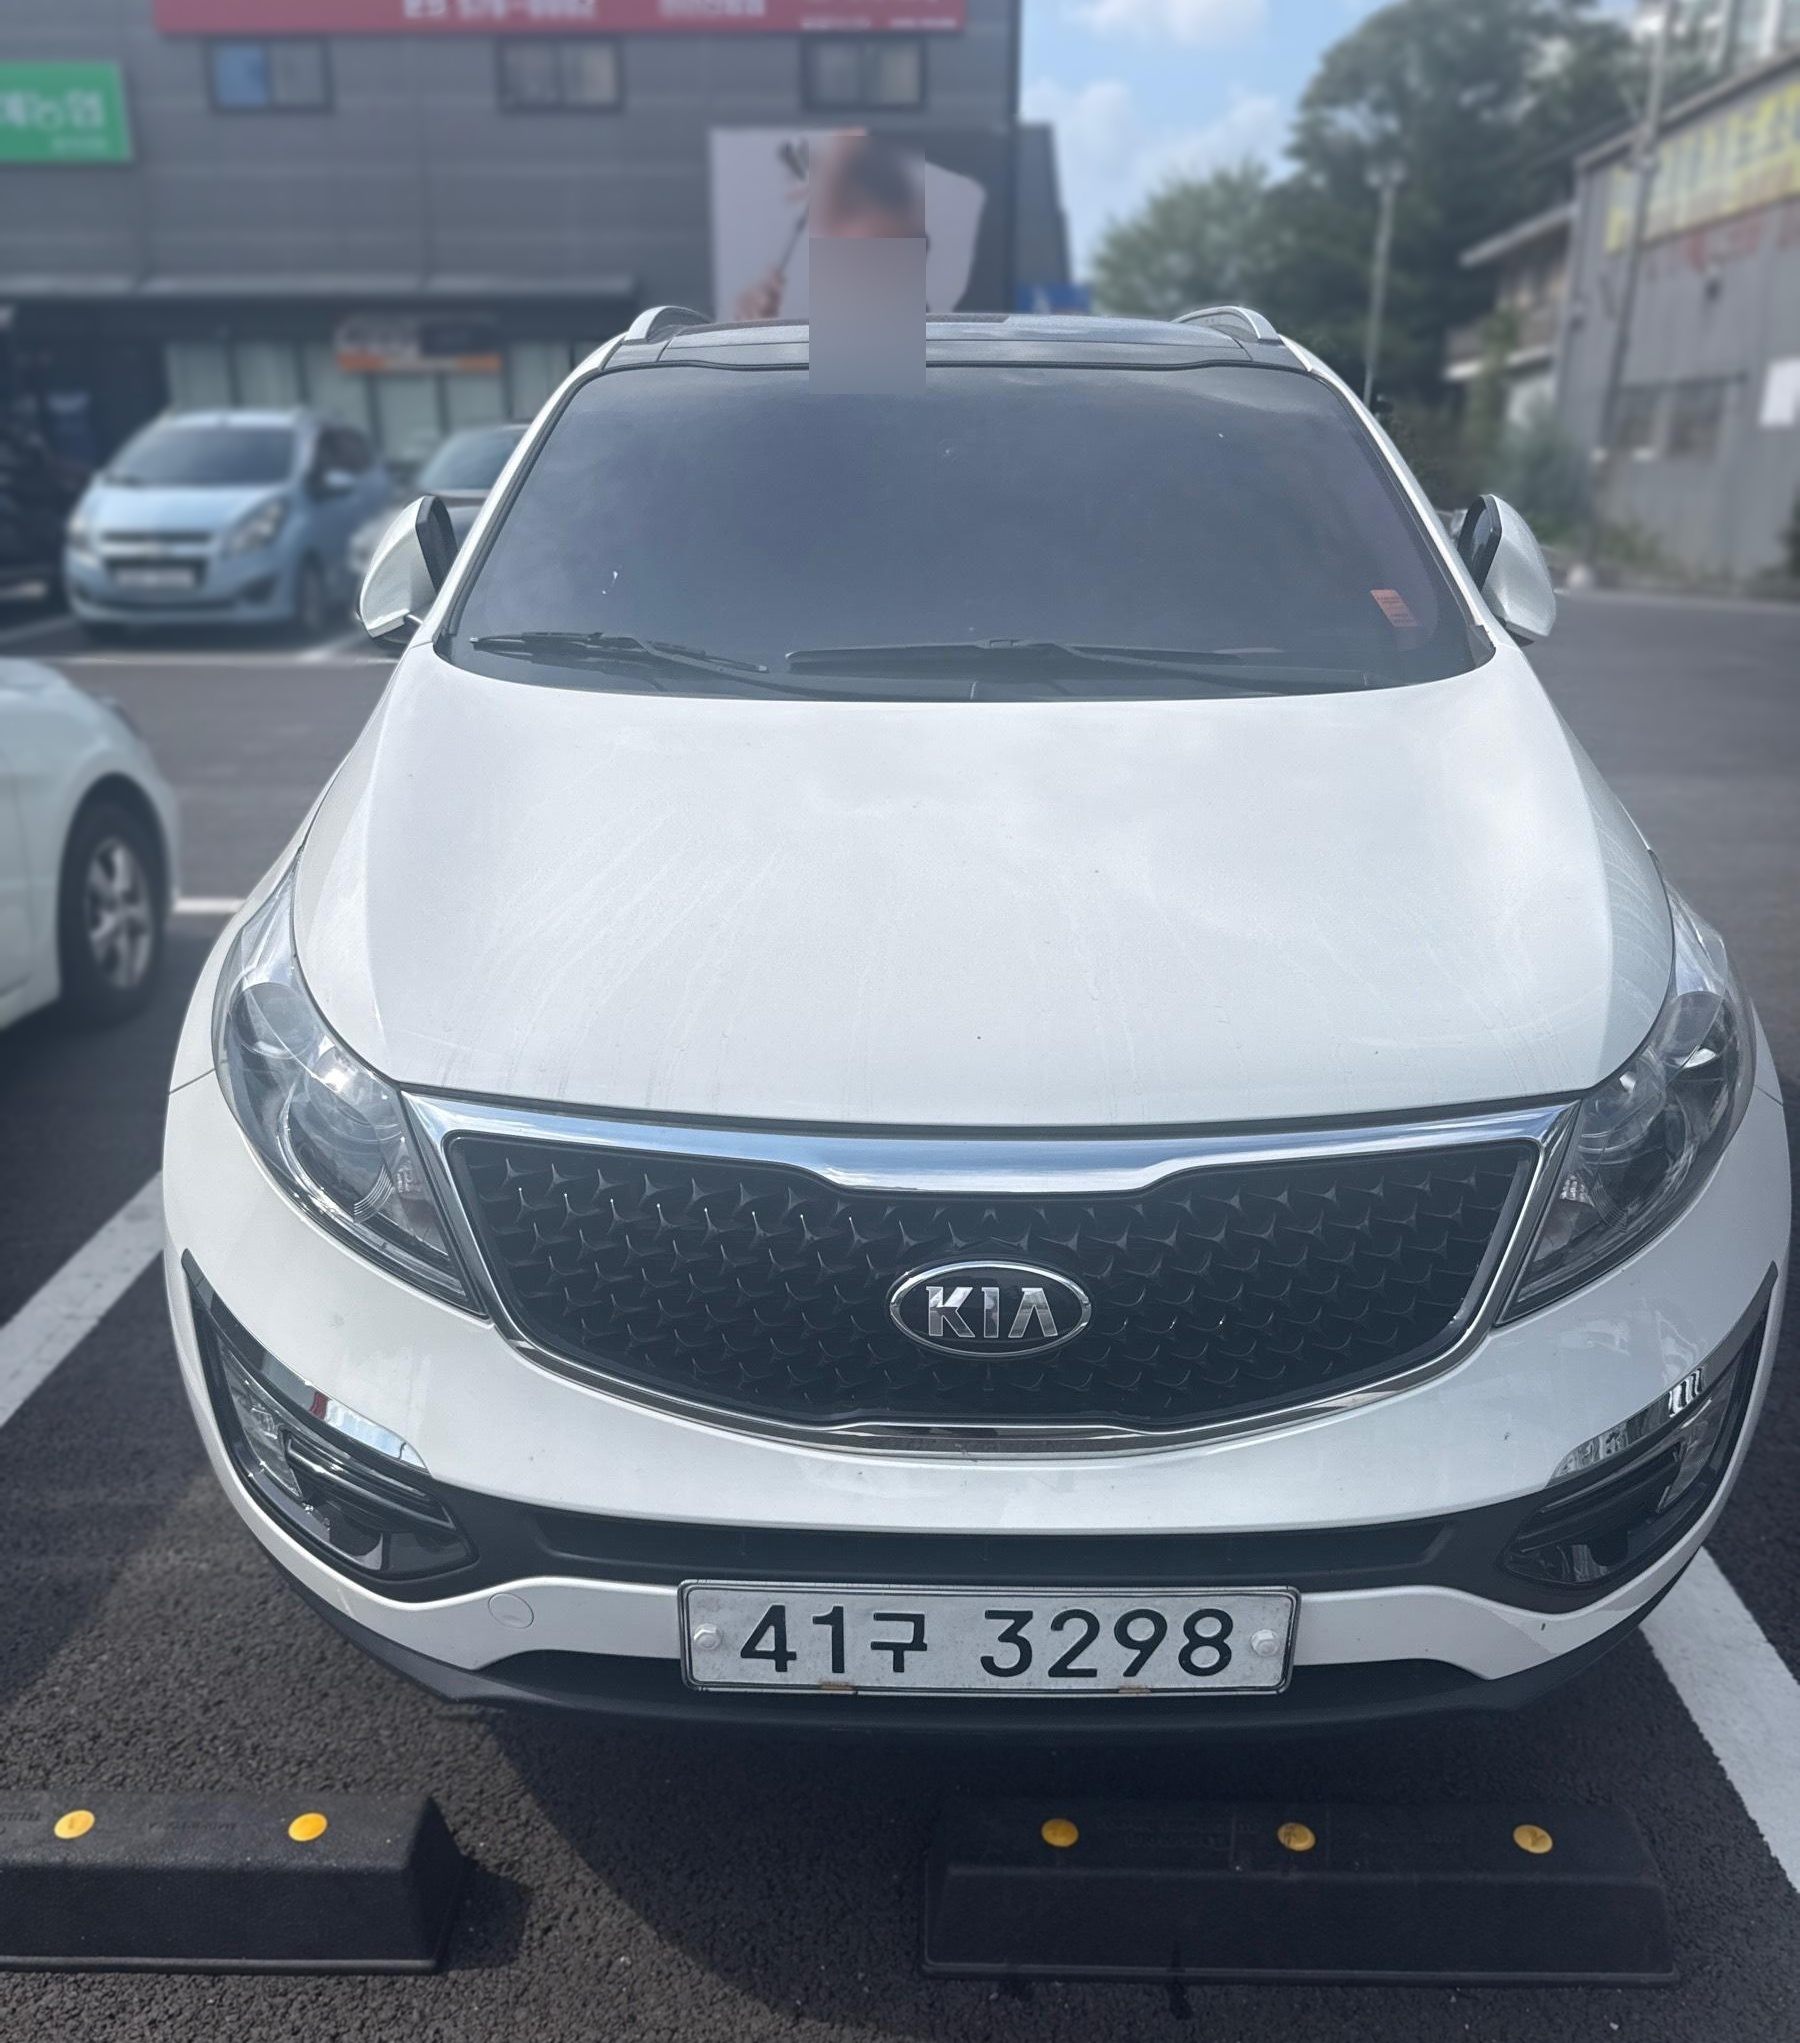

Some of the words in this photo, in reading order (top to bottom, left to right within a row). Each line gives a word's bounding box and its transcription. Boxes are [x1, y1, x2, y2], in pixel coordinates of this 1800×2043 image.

[926, 1286, 1059, 1339] KIA
[739, 1603, 928, 1674] 41구
[979, 1607, 1235, 1678] 3298
